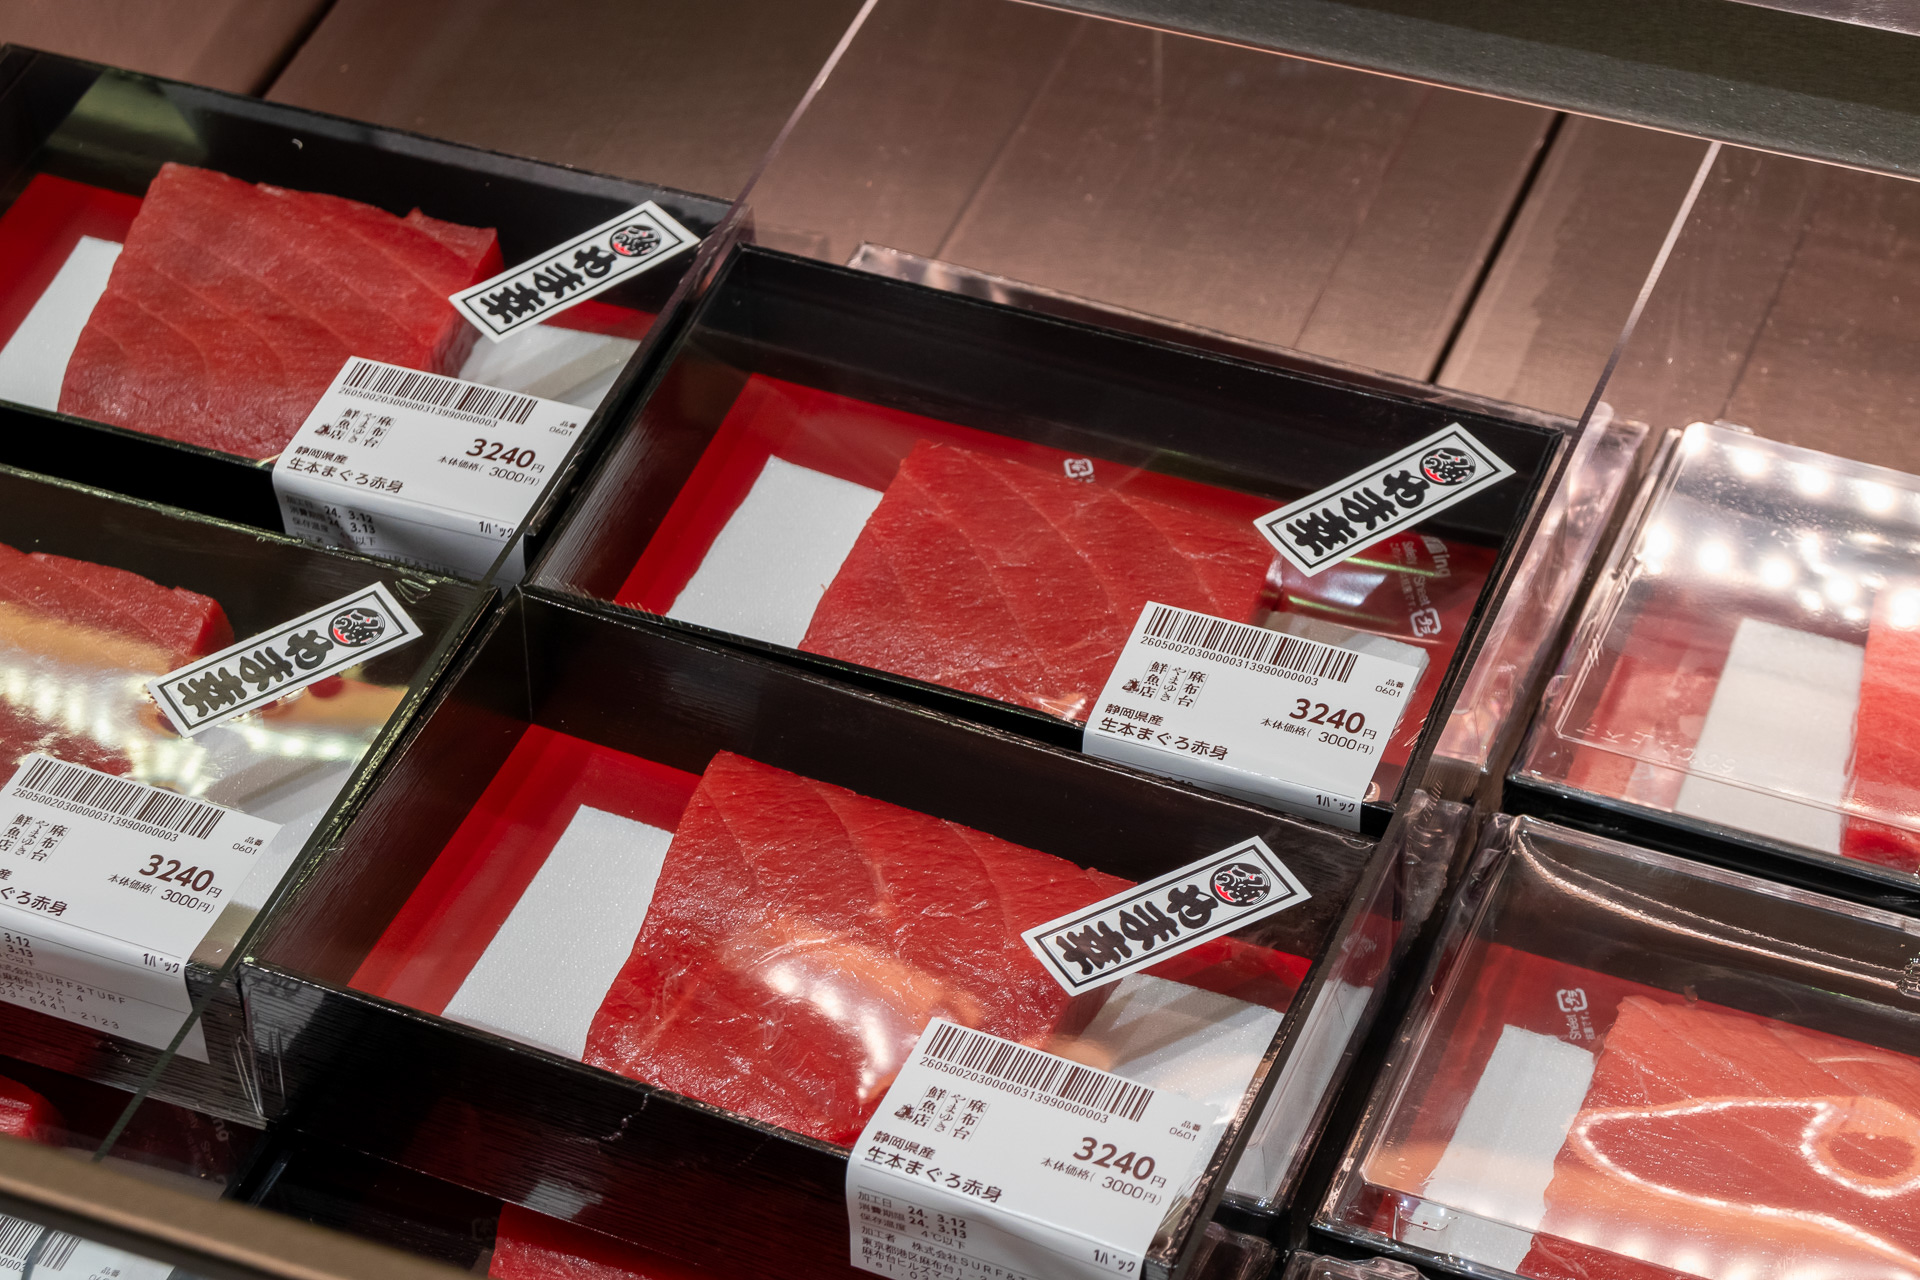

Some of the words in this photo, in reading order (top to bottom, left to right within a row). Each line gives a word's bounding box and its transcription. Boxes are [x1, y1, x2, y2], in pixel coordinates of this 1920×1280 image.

[330, 408, 357, 441] 鮮魚店
[348, 412, 375, 444] やまゆき
[364, 416, 394, 448] 麻布台
[549, 425, 573, 436] 0601
[295, 446, 349, 464] 静岡県産
[287, 457, 403, 493] 生本まぐろ赤身
[1139, 661, 1167, 699] 鮮魚店
[1160, 666, 1187, 702] やまゆき
[1177, 670, 1206, 708] 麻布台
[1375, 685, 1401, 698] 0601
[1385, 678, 1405, 688] 品番
[1104, 702, 1164, 727] 静岡県産
[1098, 717, 1229, 761] 生本まぐろ赤身
[0, 813, 31, 853] 鮮魚店
[14, 820, 49, 856] やまゆき
[32, 823, 68, 862] 麻布台
[232, 842, 258, 855] 0601
[244, 836, 264, 847] 品番
[912, 1086, 946, 1128] 鮮魚店
[934, 1094, 967, 1132] やまゆき
[953, 1097, 987, 1140] 麻布台
[1169, 1126, 1197, 1141] 0601
[1181, 1120, 1202, 1132] 品番
[873, 1130, 937, 1160] 静岡県産
[865, 1146, 1003, 1203] 生本まぐろ赤身
[858, 1191, 892, 1208] 加工日
[862, 1226, 895, 1243] 加工者
[938, 1224, 967, 1239] 3.13
